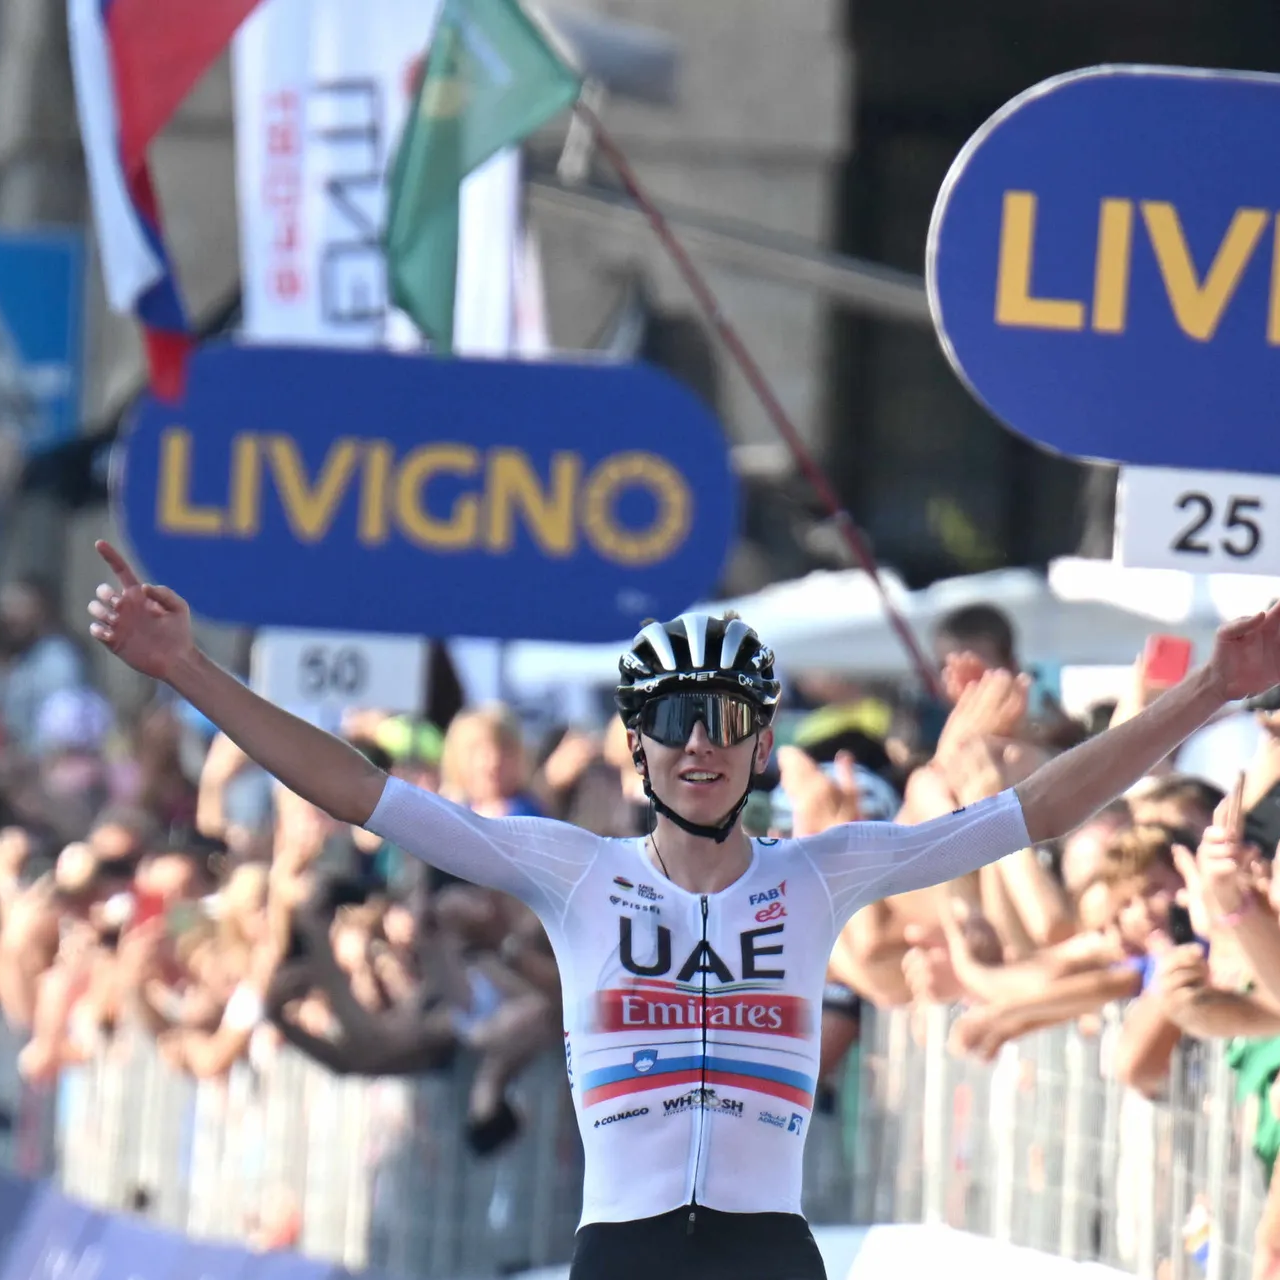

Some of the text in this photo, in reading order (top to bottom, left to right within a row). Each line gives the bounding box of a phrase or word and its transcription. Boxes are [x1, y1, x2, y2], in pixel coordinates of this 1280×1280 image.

[156, 426, 692, 567] LIVIGNO
[1170, 491, 1263, 558] 25
[300, 645, 369, 697] 50
[678, 670, 718, 681] MET
[749, 888, 780, 906] FAB
[620, 915, 785, 983] UAE
[620, 995, 782, 1029] Emirates
[601, 1107, 649, 1125] COLNAGO
